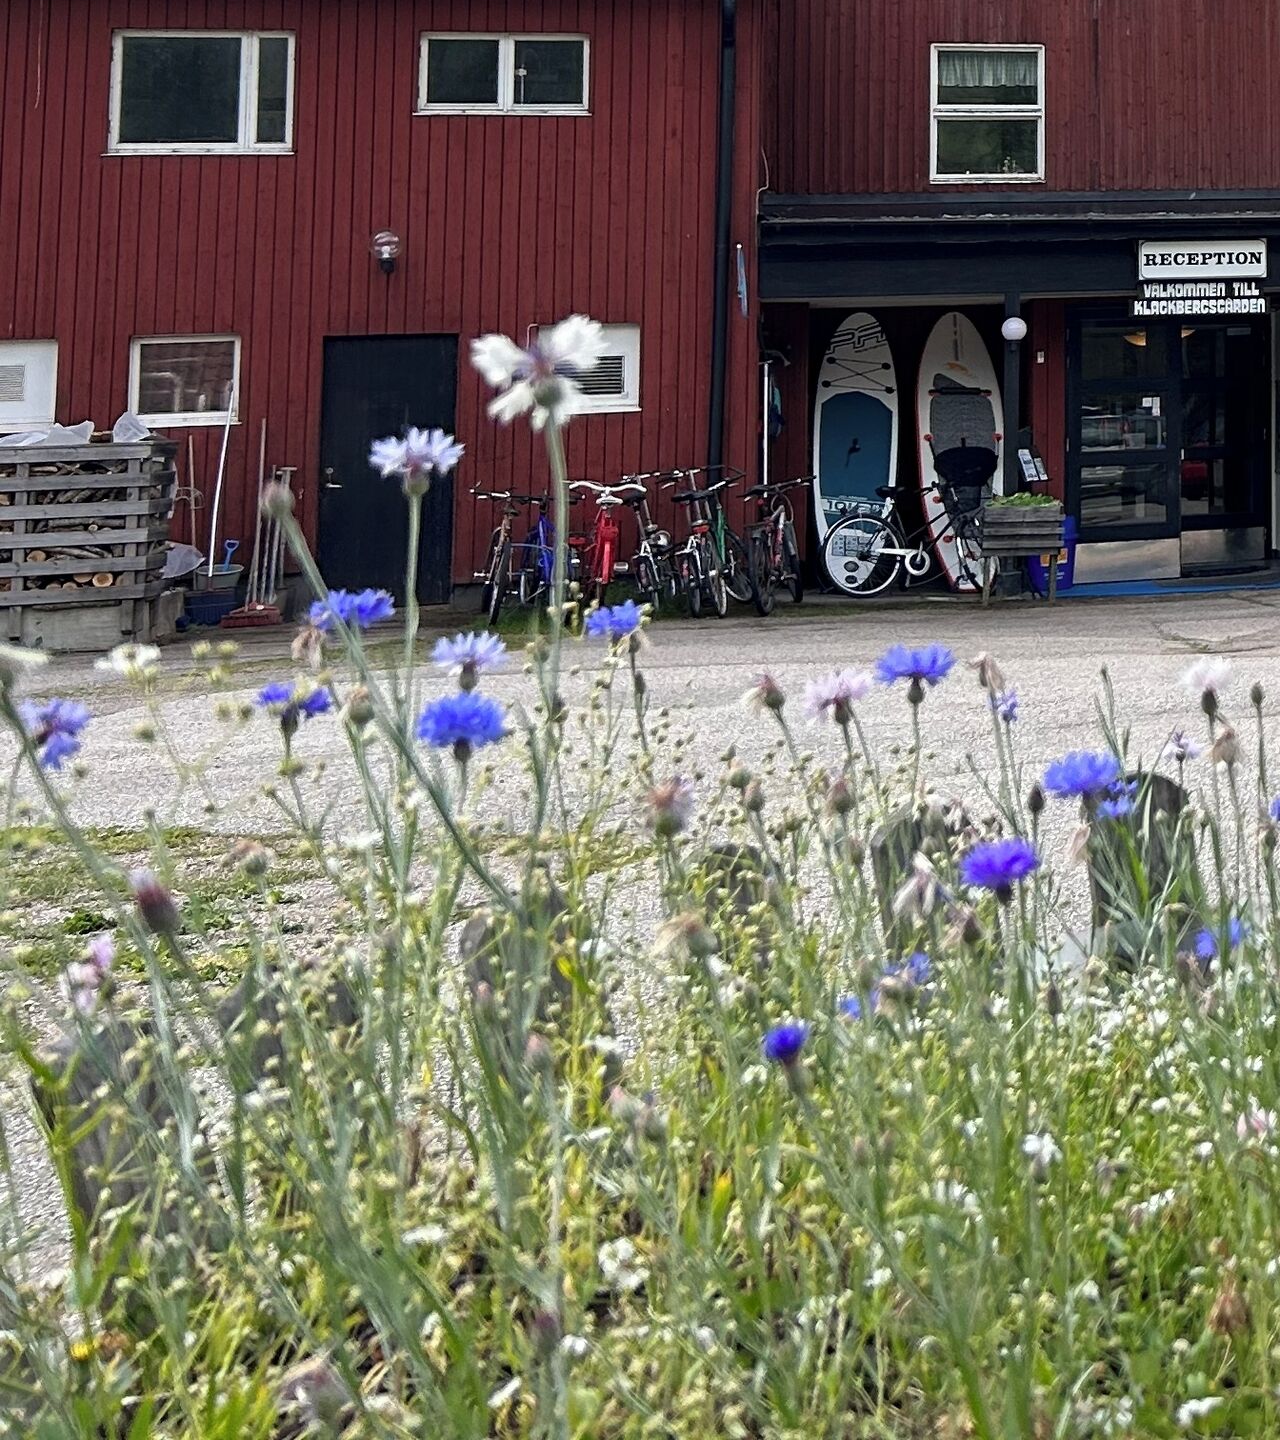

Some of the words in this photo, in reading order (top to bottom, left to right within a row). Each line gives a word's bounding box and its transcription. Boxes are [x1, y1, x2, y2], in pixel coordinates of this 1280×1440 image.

[1143, 251, 1263, 266] RECEPTION
[1143, 282, 1226, 298] VÄLKOMMEN
[1232, 282, 1260, 296] TILL
